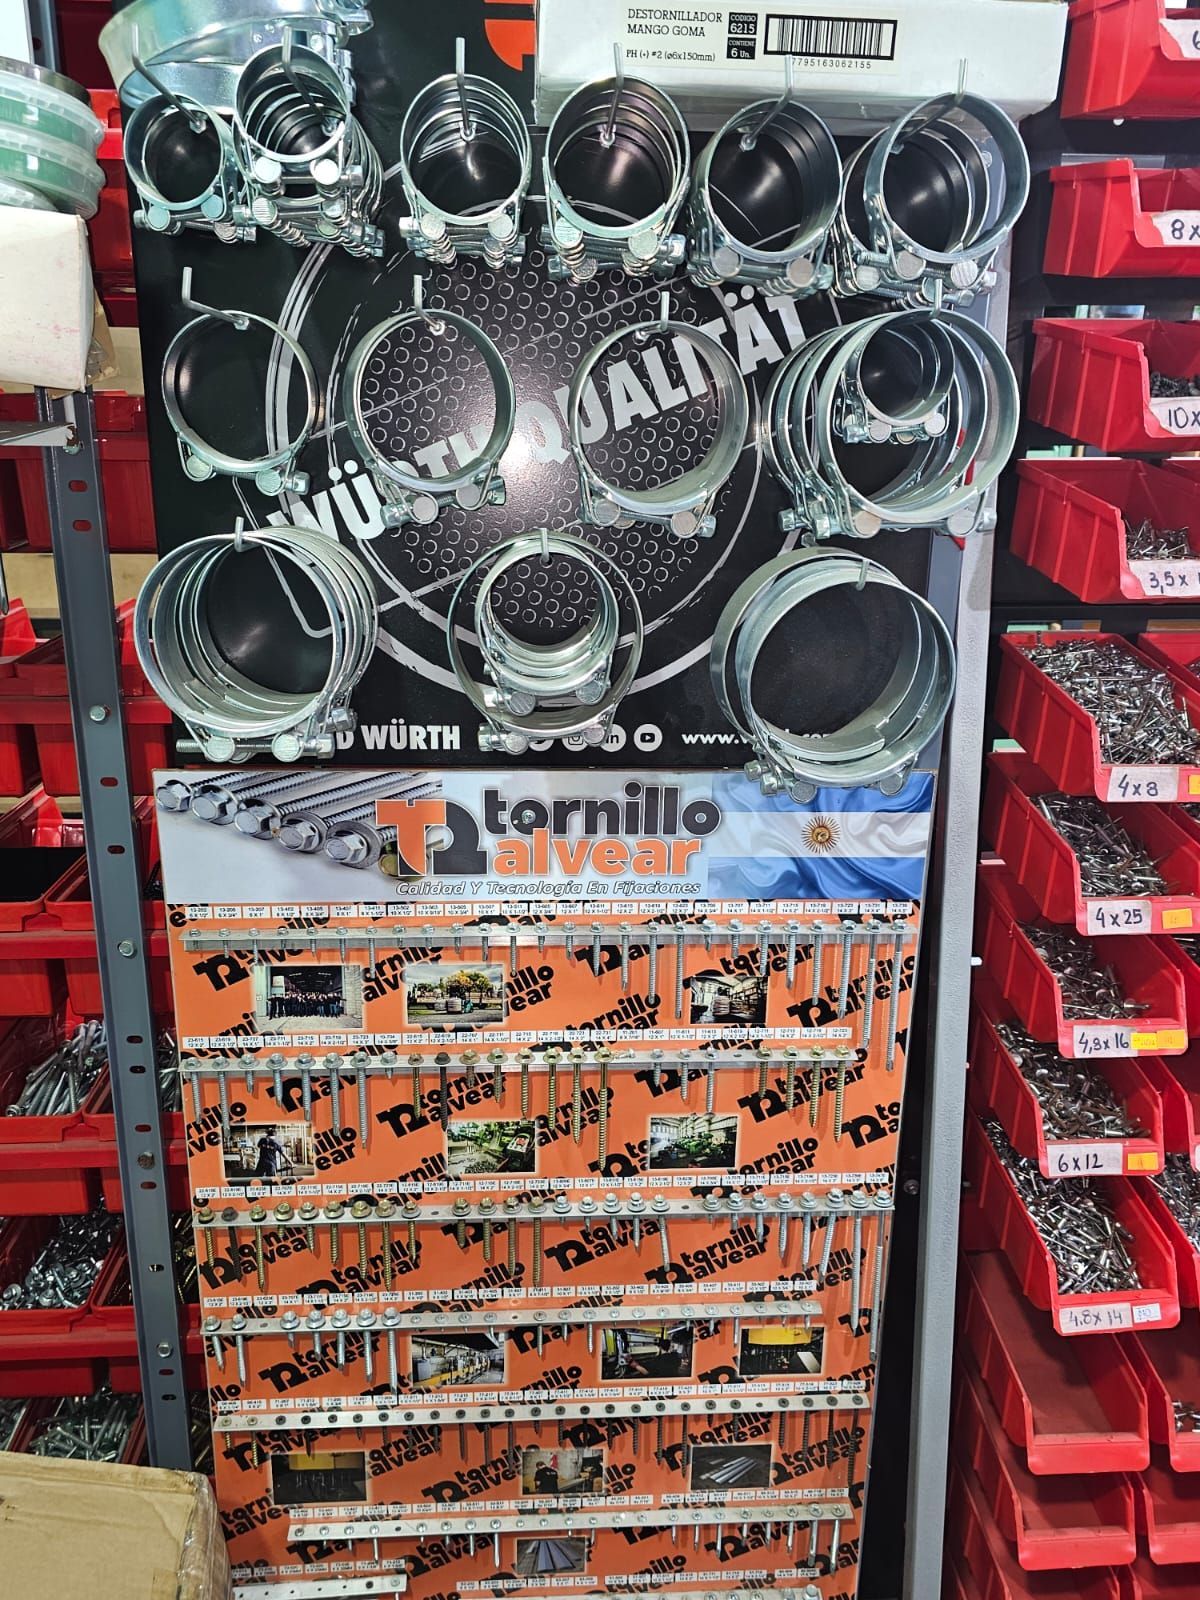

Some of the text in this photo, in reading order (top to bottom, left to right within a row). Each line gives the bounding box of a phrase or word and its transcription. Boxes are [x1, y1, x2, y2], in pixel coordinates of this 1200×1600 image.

[627, 8, 723, 23] DESTORNILLADOR
[627, 23, 706, 37] MANGO GOMA
[730, 23, 756, 34] 6215
[626, 49, 638, 58] PH
[731, 48, 738, 57] 6
[361, 718, 461, 750] WÜRTH
[483, 780, 722, 837] tornillo
[493, 827, 701, 876] alvear
[396, 880, 701, 898] Calidad Y Tecnología En Fijaciones
